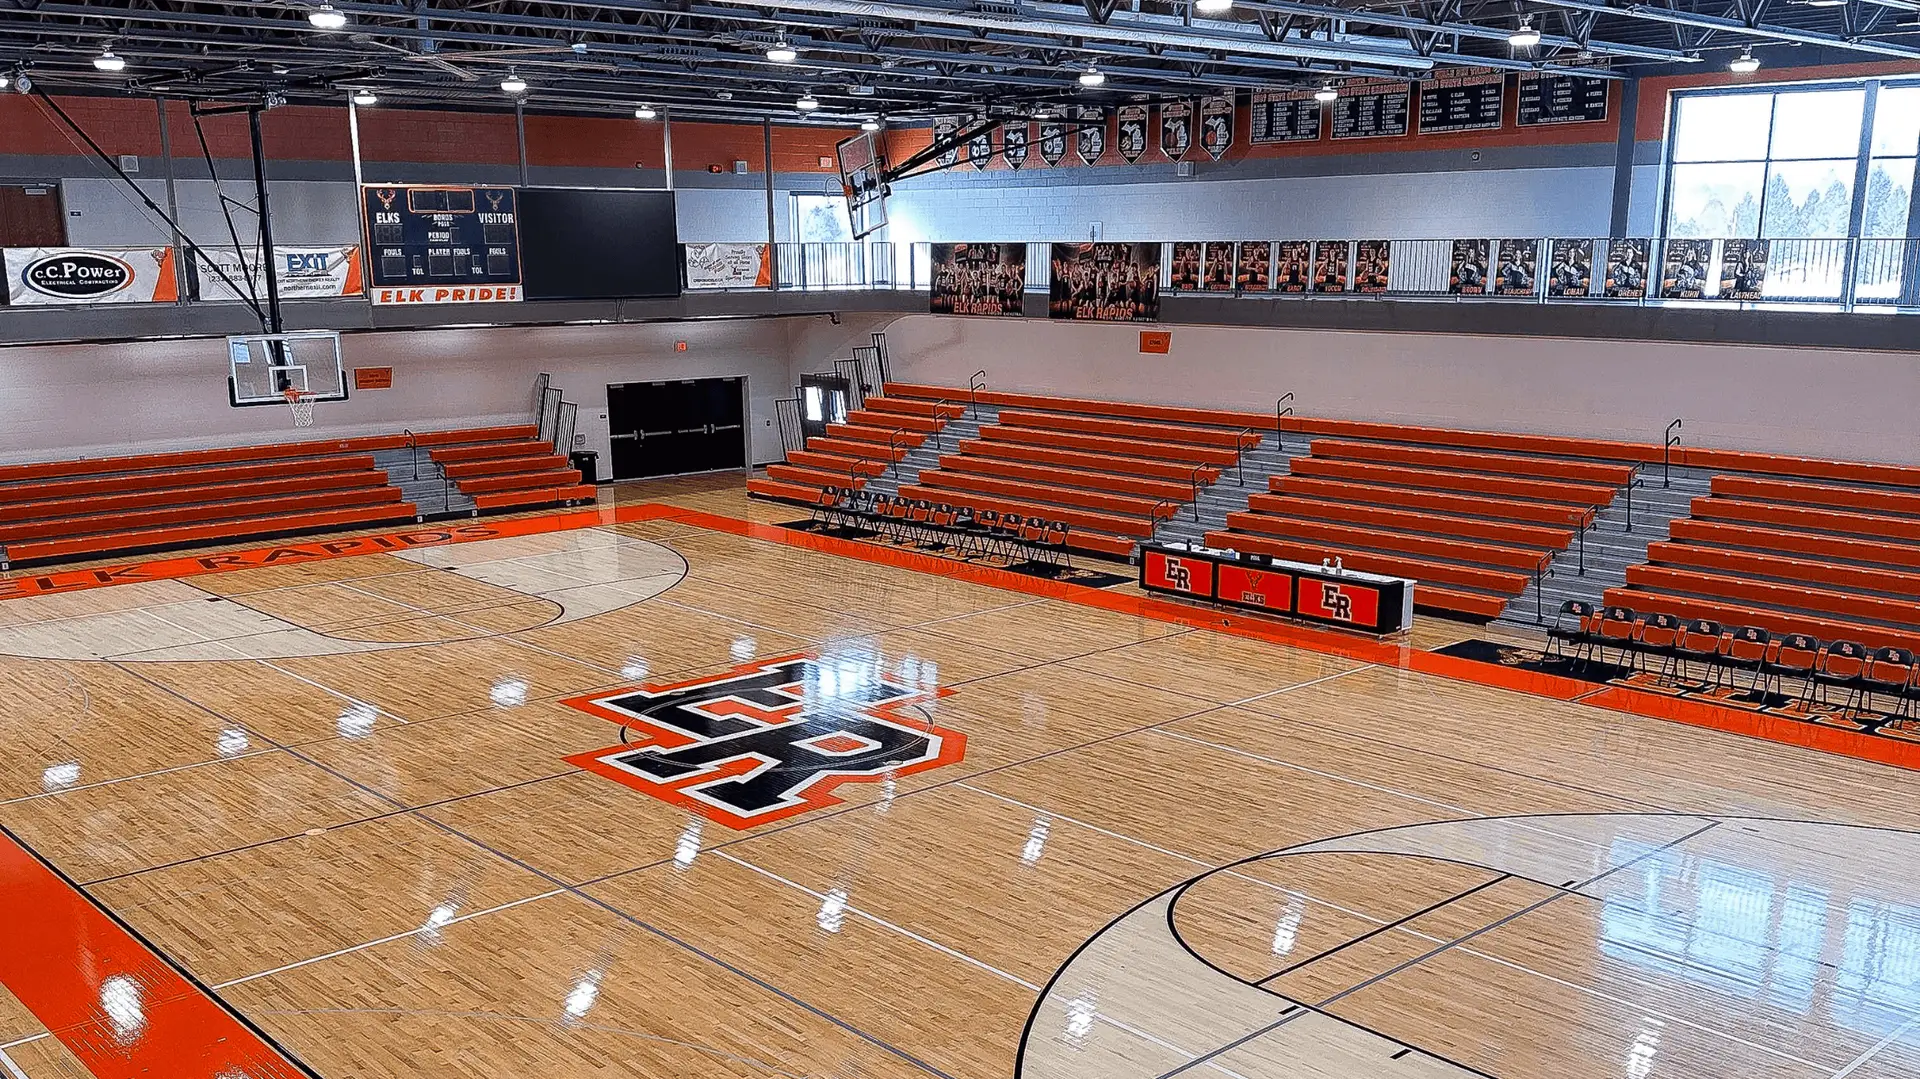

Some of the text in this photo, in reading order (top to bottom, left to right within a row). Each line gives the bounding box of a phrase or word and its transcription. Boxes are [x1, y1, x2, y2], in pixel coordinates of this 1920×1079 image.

[376, 212, 400, 223] ELKS
[478, 213, 514, 223] VISITOR
[200, 263, 267, 273] SCTT MORE
[380, 287, 516, 303] ELK PRIDE!
[953, 302, 1003, 314] ELK RAPIDS
[1076, 306, 1133, 319] ELK RAPIDS
[198, 524, 500, 570] RAPIDS
[1164, 555, 1192, 592] ER
[1321, 582, 1352, 621] ER
[570, 654, 960, 827] ER
